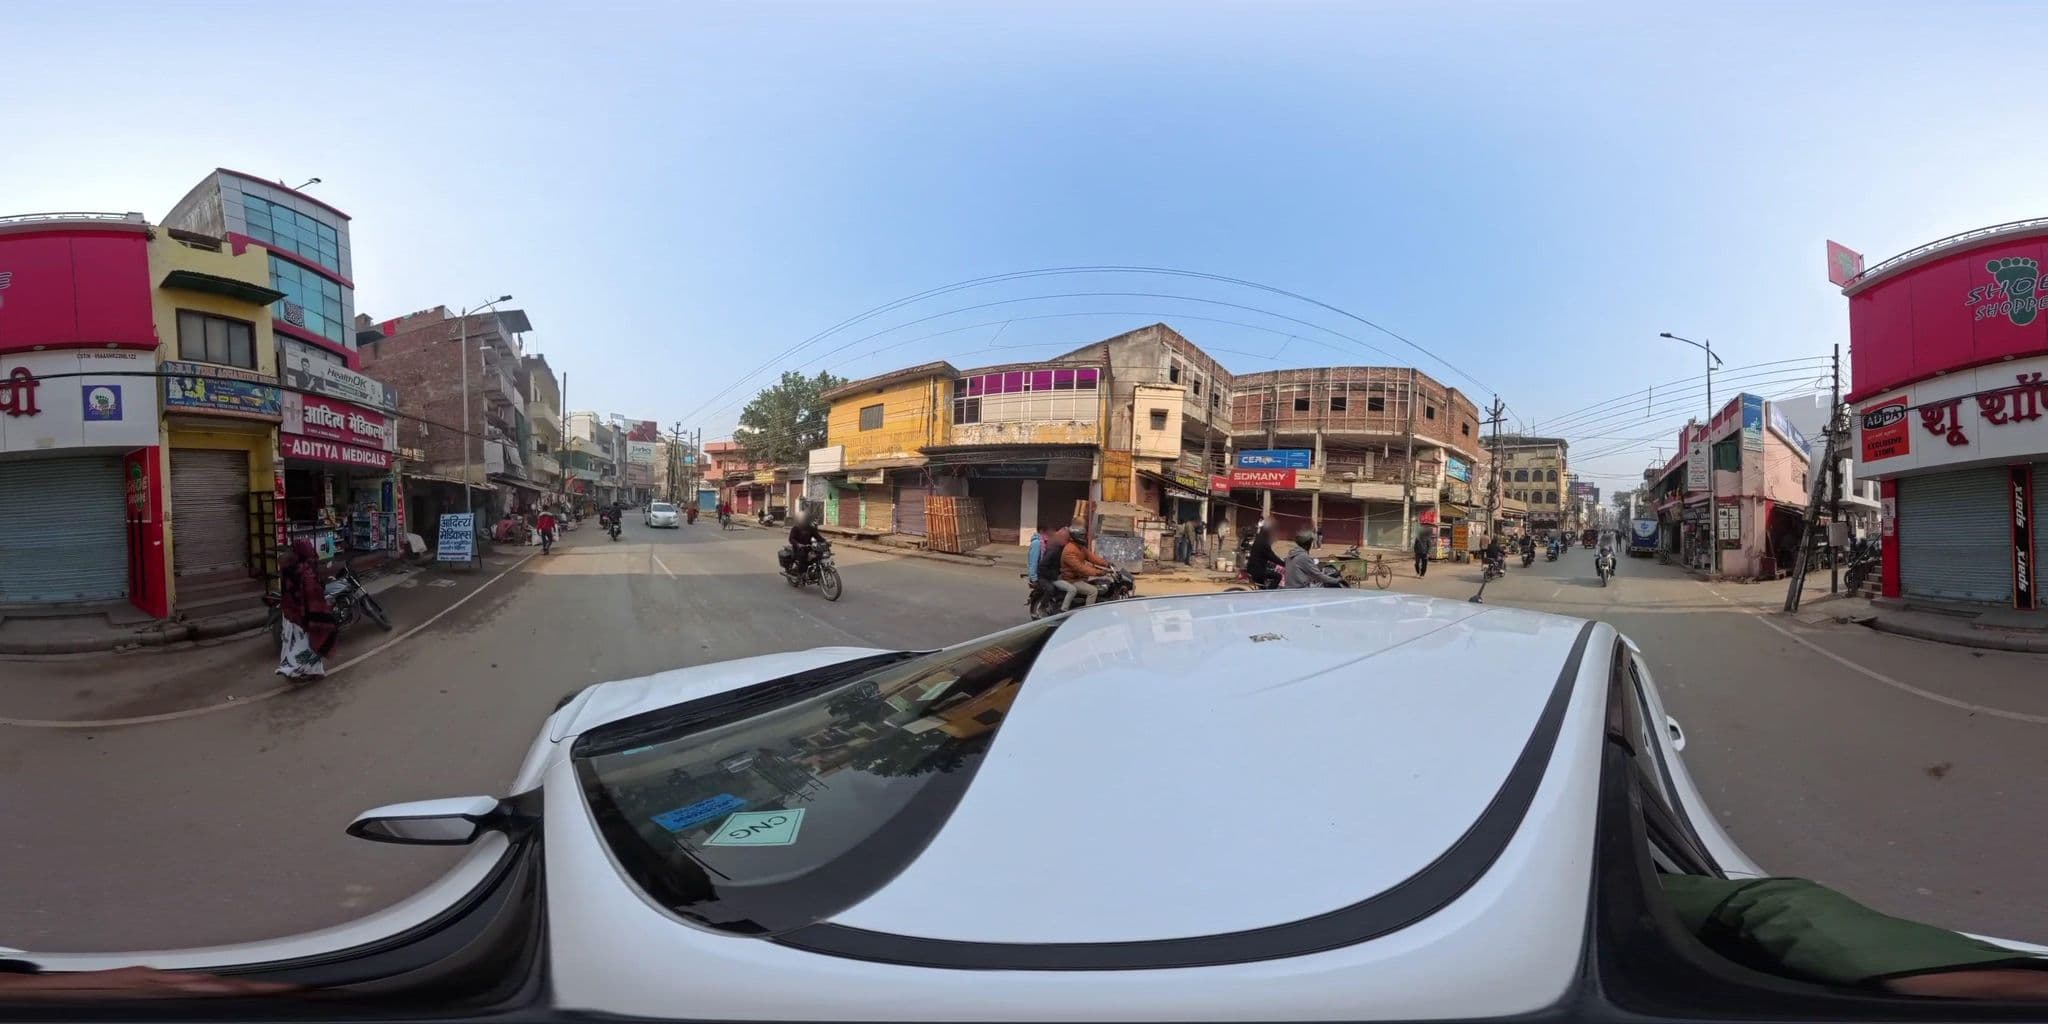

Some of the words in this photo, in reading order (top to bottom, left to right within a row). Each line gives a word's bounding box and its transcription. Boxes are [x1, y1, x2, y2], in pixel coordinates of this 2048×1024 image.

[304, 404, 345, 429] आदित्य
[1917, 399, 1969, 447] शू
[292, 439, 339, 459] ADITYA
[342, 447, 386, 466] MEDICALS
[1233, 472, 1286, 481] SOMANY
[2013, 480, 2027, 528] sparx
[2016, 546, 2029, 592] sparx
[729, 815, 788, 839] CNG
